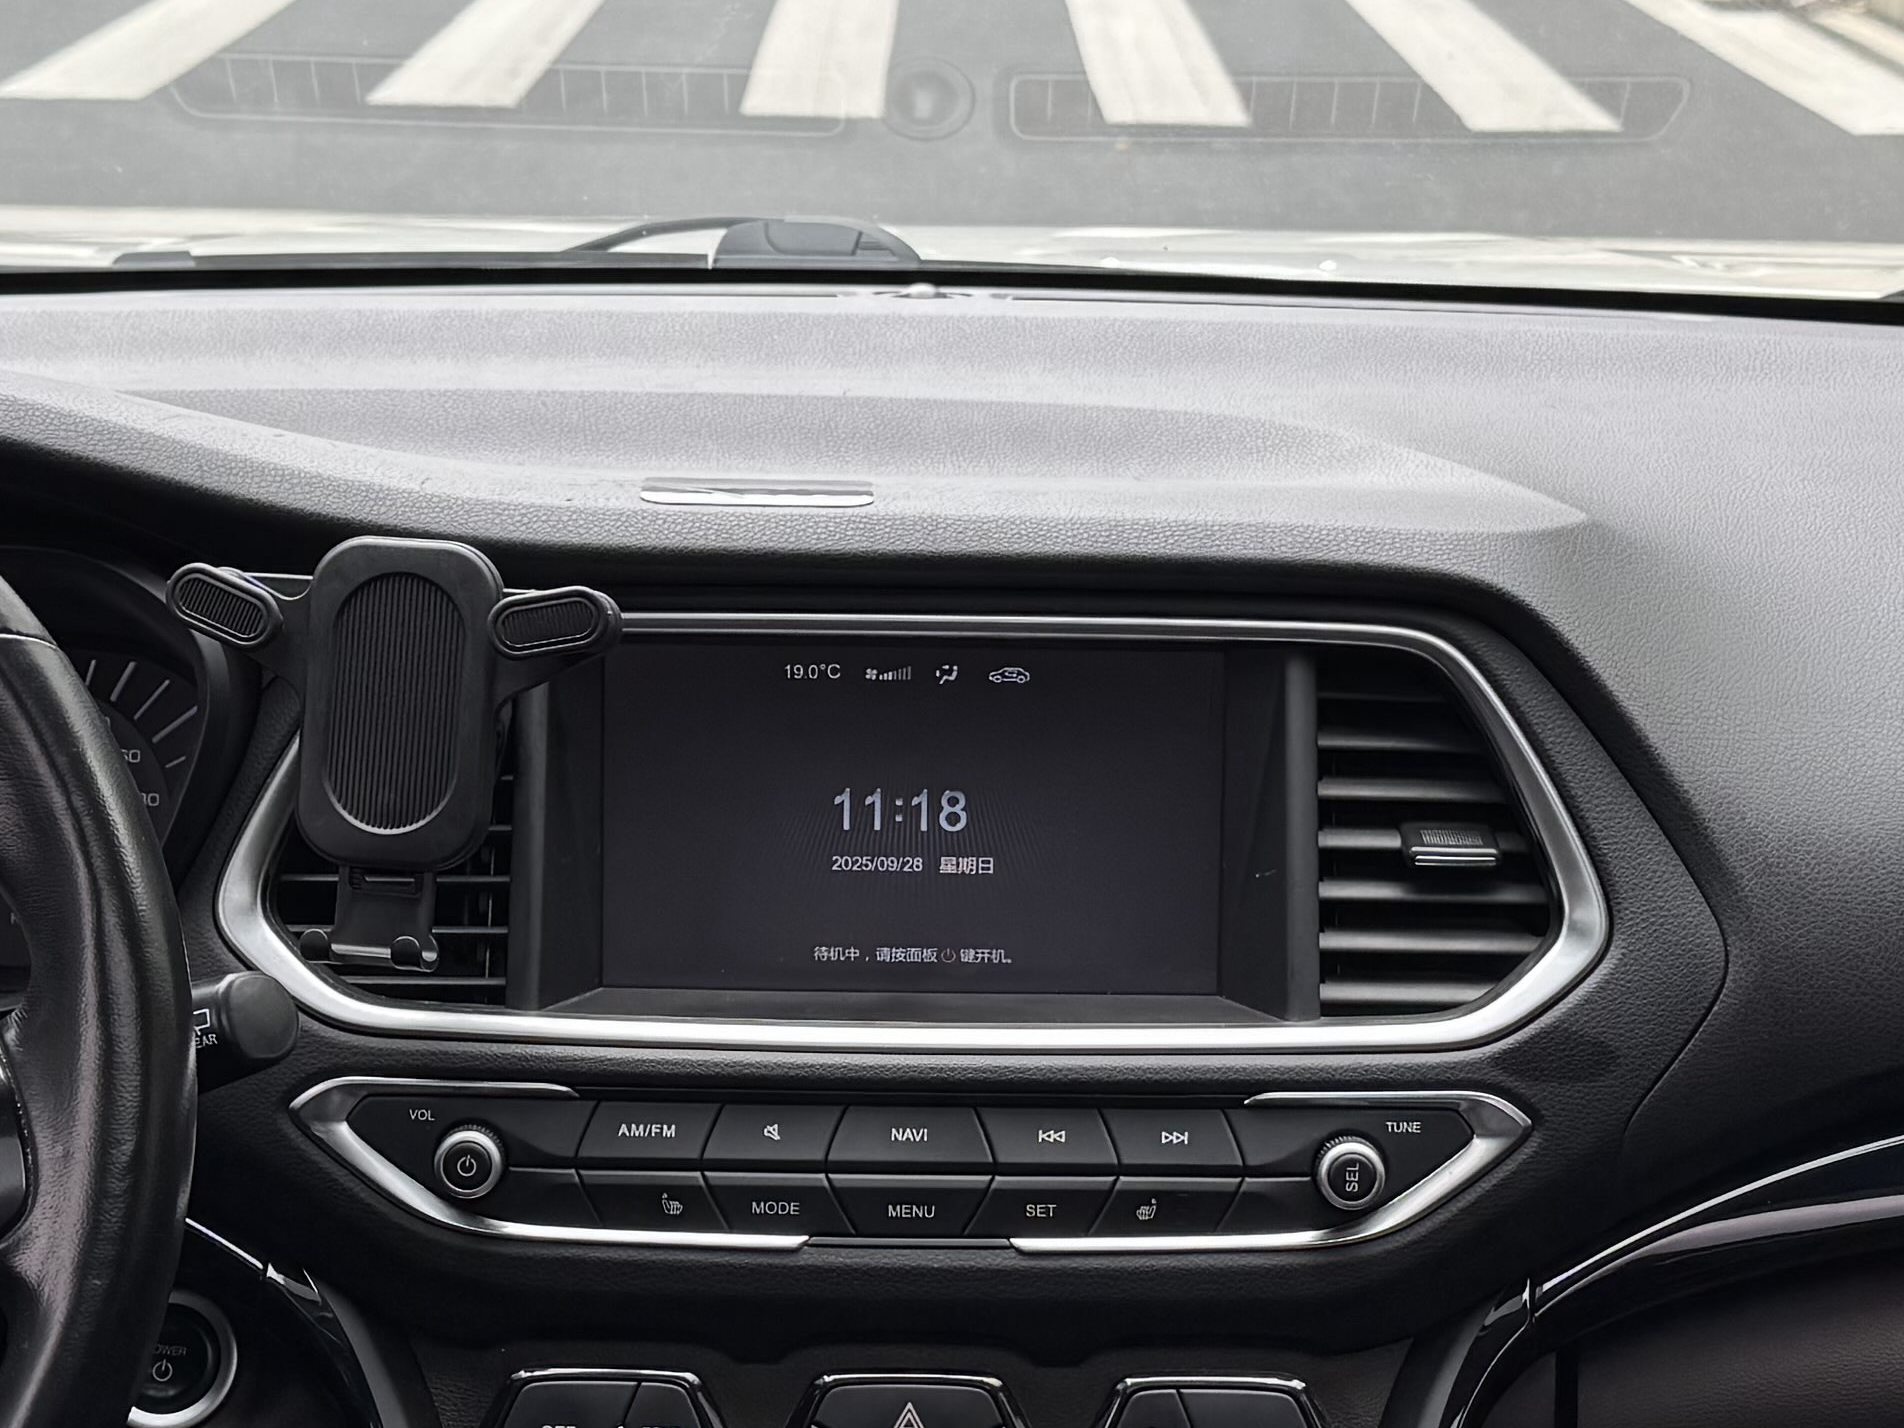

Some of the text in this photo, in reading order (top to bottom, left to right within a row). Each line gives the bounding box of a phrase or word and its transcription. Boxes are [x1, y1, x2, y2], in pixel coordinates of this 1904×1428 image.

[783, 663, 842, 681] 19.0°C
[833, 786, 969, 834] 11:18
[830, 855, 995, 875] 2025/09/28 星期日
[194, 1033, 219, 1049] EAR
[408, 1108, 436, 1122] VOL
[616, 1122, 677, 1140] AM/FM
[889, 1126, 929, 1143] NAVI
[1385, 1119, 1422, 1135] TUNE
[1344, 1161, 1360, 1194] SEL
[750, 1199, 801, 1217] MODE
[887, 1202, 936, 1220] MENU
[1024, 1202, 1057, 1219] SET
[153, 1343, 187, 1357] OWER
